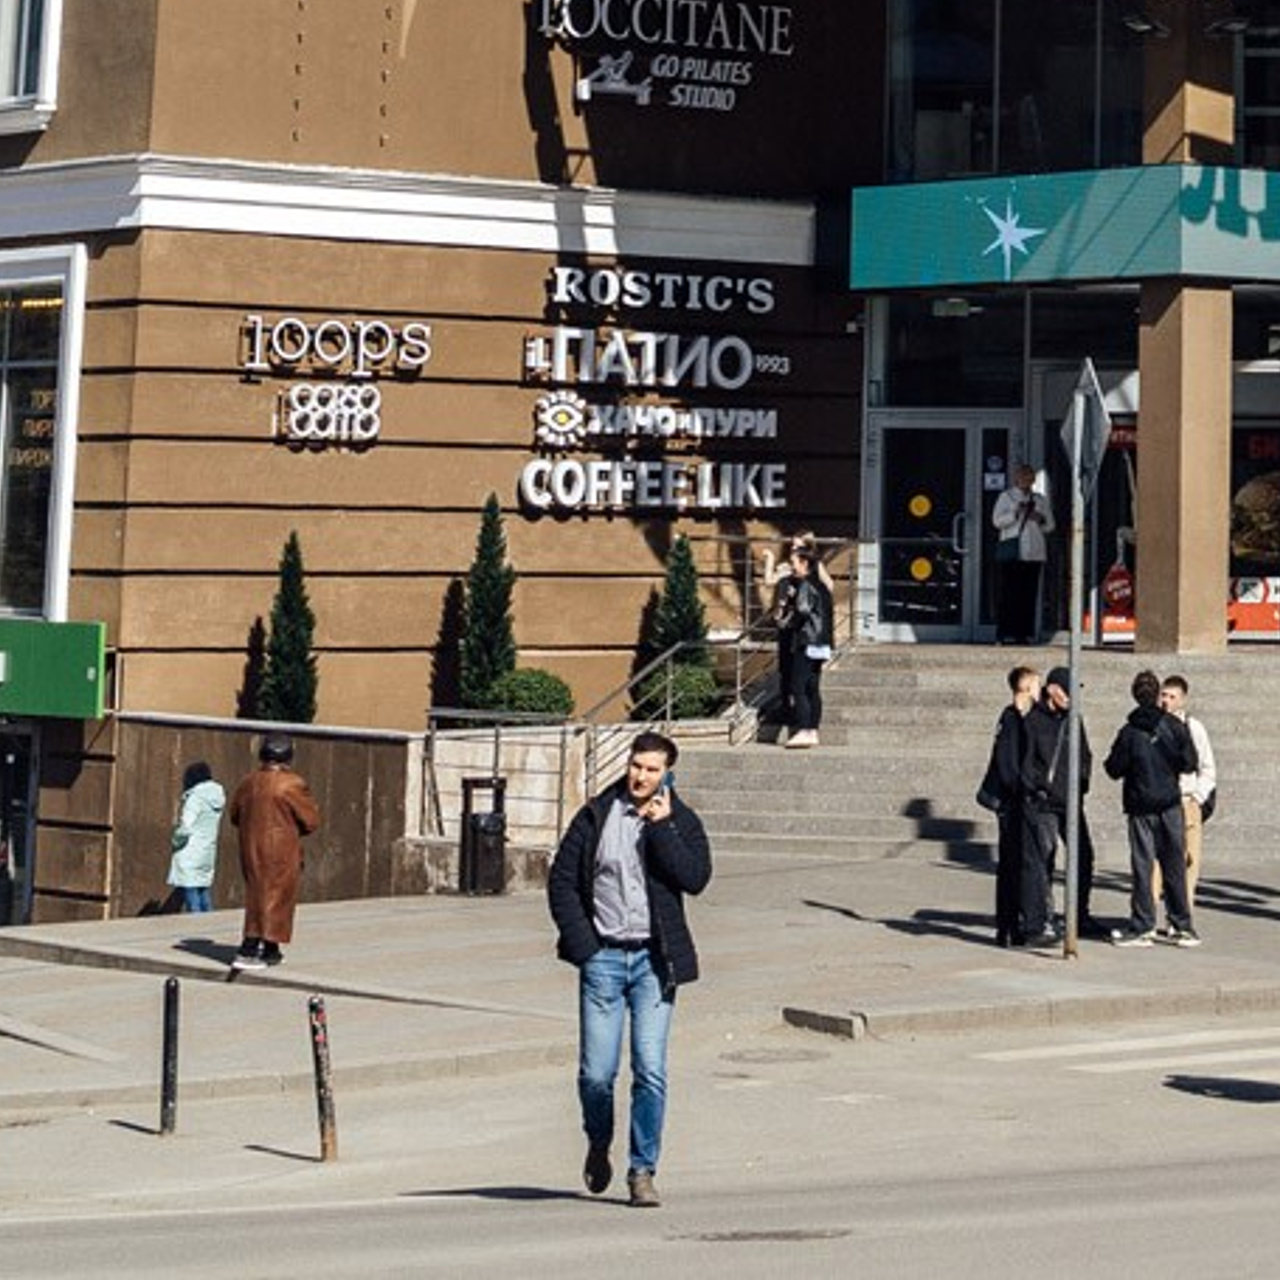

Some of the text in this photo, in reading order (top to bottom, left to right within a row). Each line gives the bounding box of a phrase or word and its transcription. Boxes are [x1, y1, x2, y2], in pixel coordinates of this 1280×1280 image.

[651, 53, 753, 86] GO PILATES
[668, 85, 737, 112] STUDIO
[552, 266, 776, 315] ROSTIC'S
[245, 314, 432, 377] loops
[552, 326, 753, 390] ПАТИО
[756, 353, 791, 376] 1993
[588, 404, 677, 437] ХАЧО
[694, 406, 778, 438] ПУРИ
[519, 457, 787, 509] COFFEE LIKE
